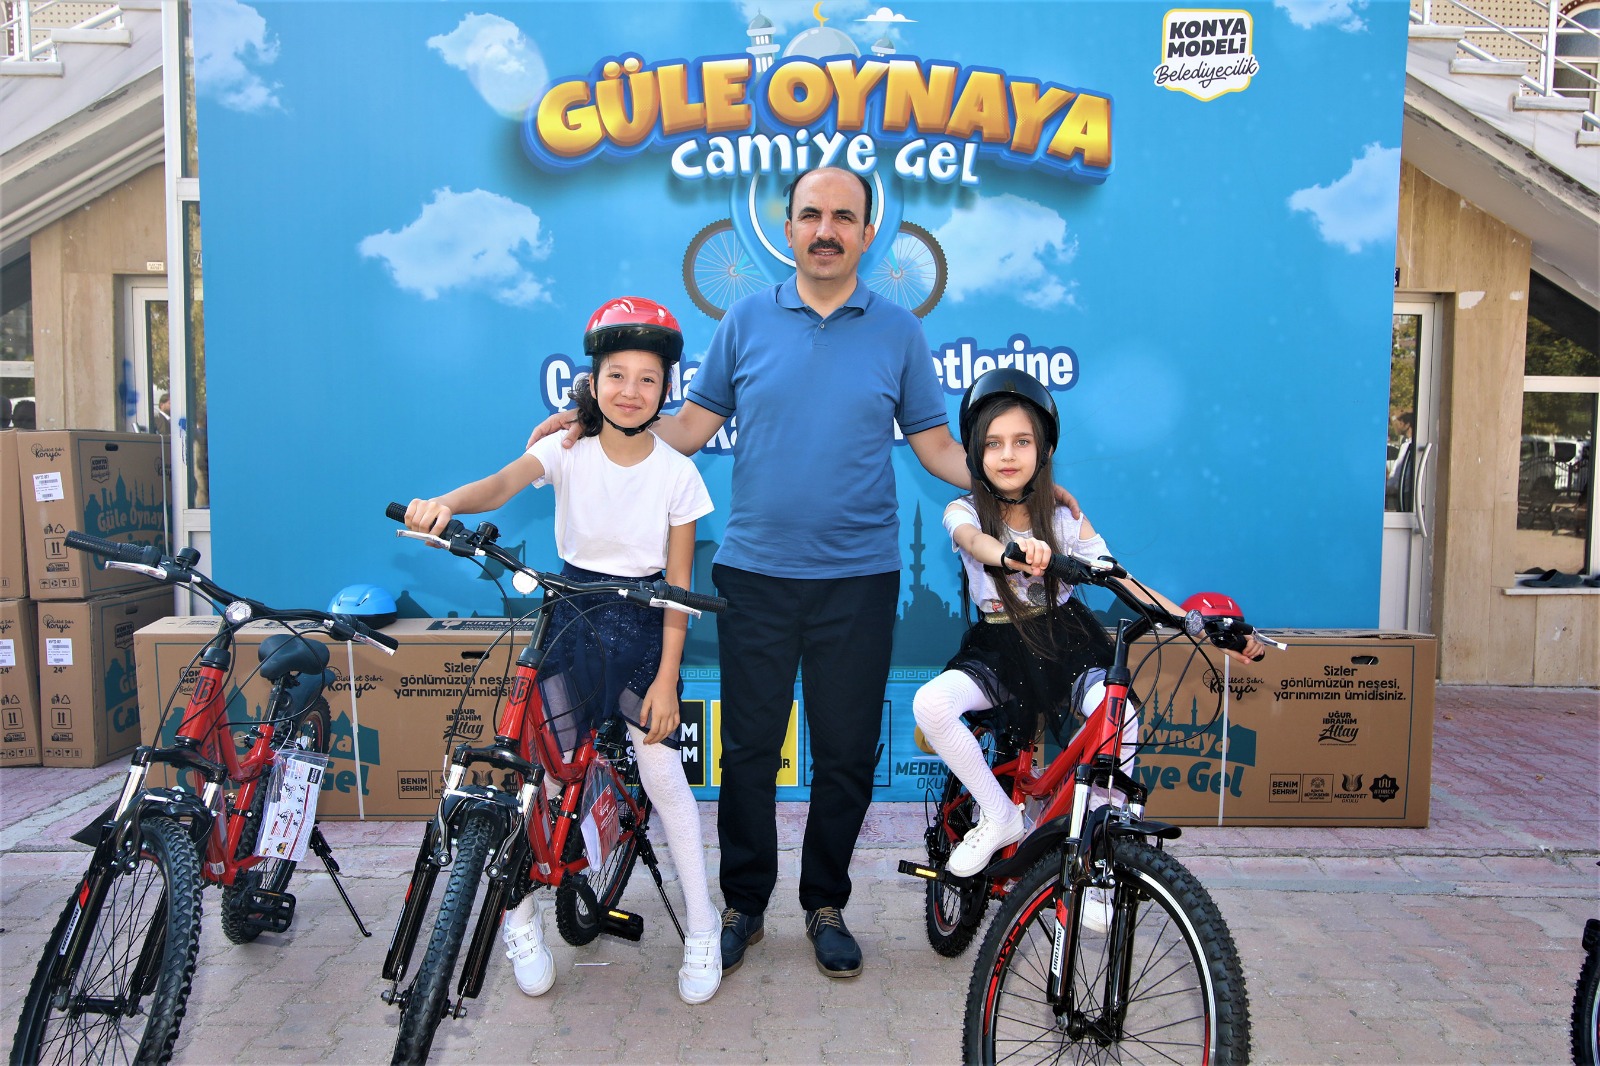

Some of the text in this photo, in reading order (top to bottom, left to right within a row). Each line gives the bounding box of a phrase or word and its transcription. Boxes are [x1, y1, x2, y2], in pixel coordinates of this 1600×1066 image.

[1169, 18, 1247, 40] KONYA
[1155, 56, 1258, 89] Belediyecilik
[537, 57, 1113, 169] GÜLE OYNAYA
[97, 506, 163, 532] Güle Oynay
[1323, 665, 1358, 676] Sizler
[400, 674, 476, 687] gönlümüzün
[1280, 677, 1400, 690] gönlümüzün neşesi,
[393, 687, 463, 699] yarınımızın
[1273, 689, 1406, 701] yarınımızın ümidisiniz.
[1328, 710, 1352, 719] UĞUR
[1317, 724, 1360, 743] Altay
[895, 762, 948, 776] MEDEN
[1187, 761, 1245, 798] Gel
